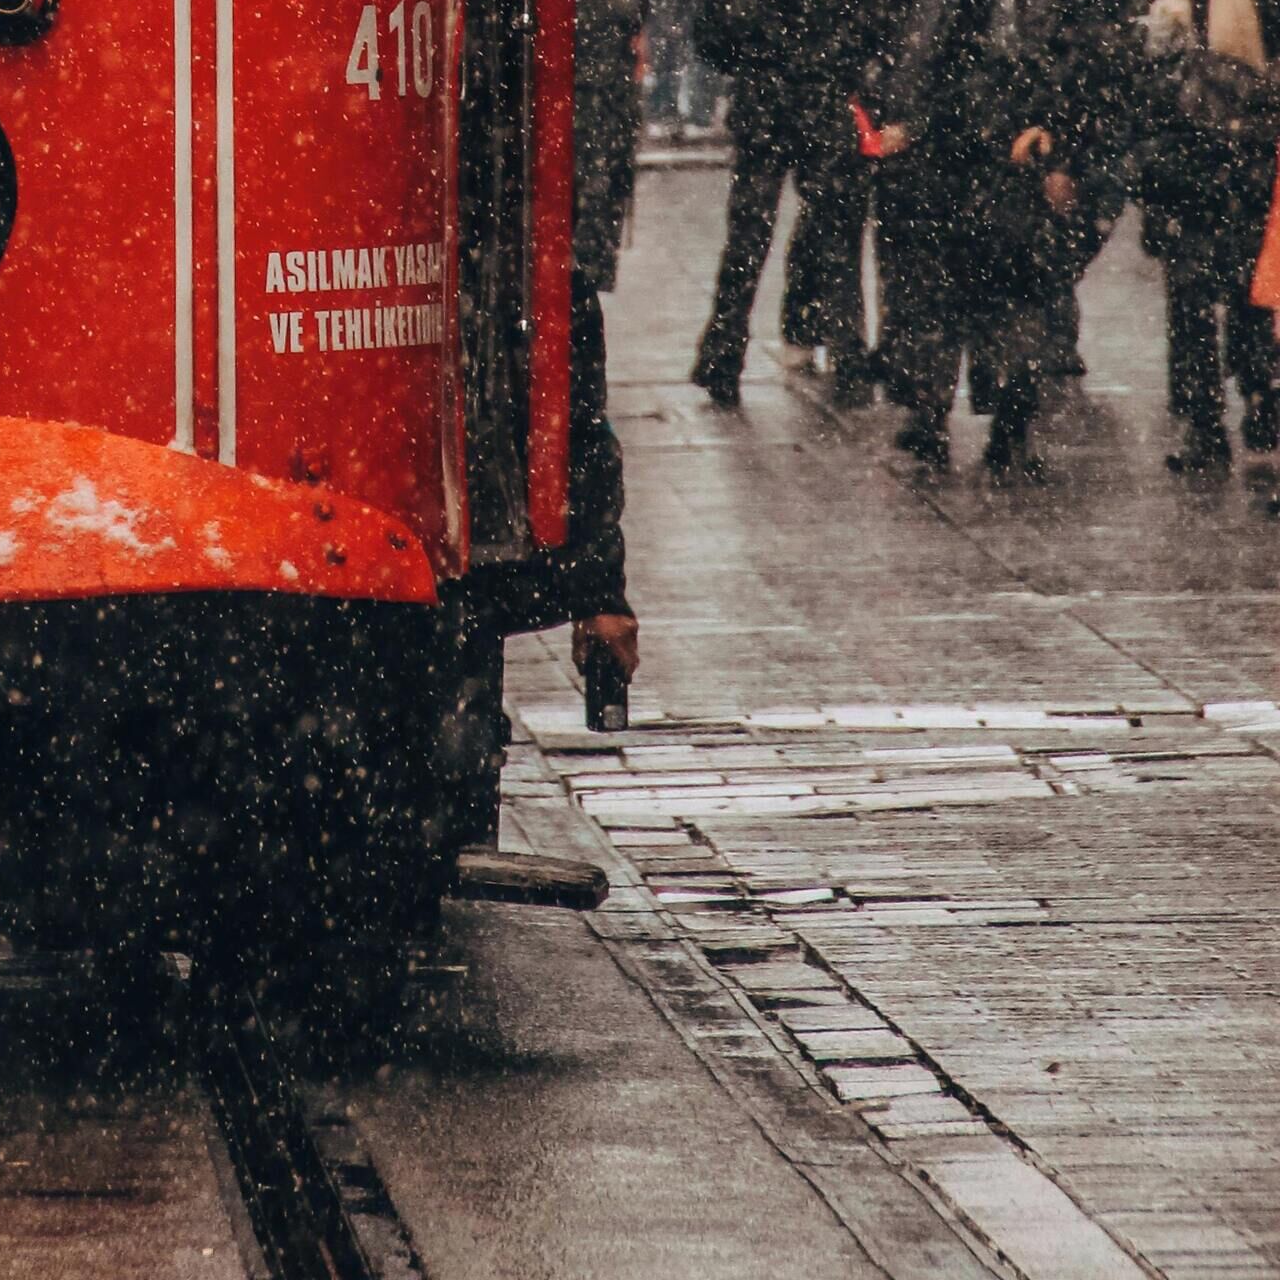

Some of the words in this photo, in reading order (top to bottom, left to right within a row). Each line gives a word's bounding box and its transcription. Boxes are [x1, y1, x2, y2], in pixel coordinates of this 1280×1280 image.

[346, 0, 433, 101] 410
[266, 246, 388, 293] ASILMAK
[270, 312, 304, 354] VE
